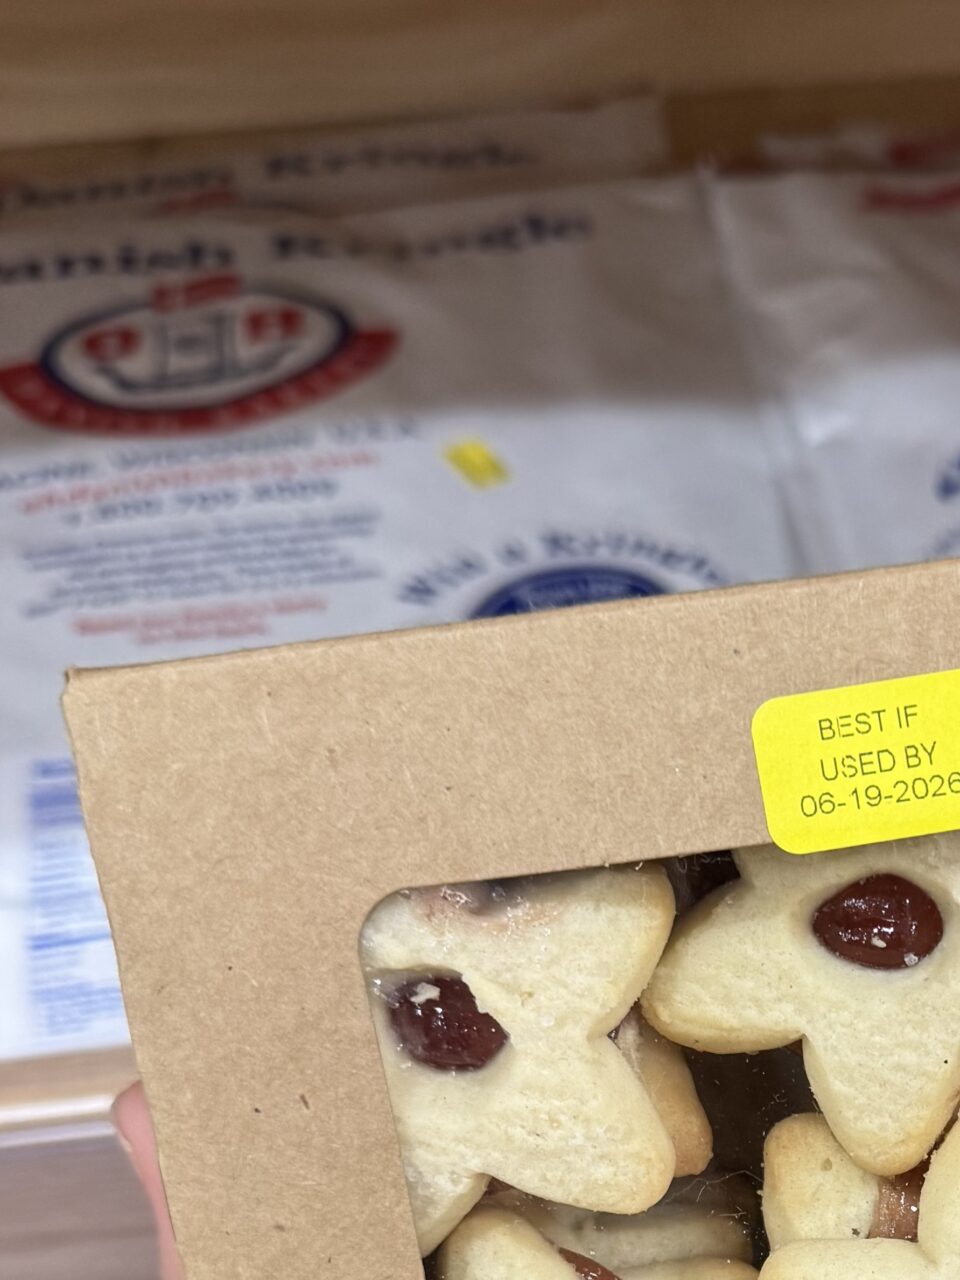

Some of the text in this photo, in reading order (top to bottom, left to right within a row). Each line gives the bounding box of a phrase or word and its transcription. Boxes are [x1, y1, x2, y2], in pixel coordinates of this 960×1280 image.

[818, 704, 918, 741] BEST IF
[820, 741, 937, 782] USED BY
